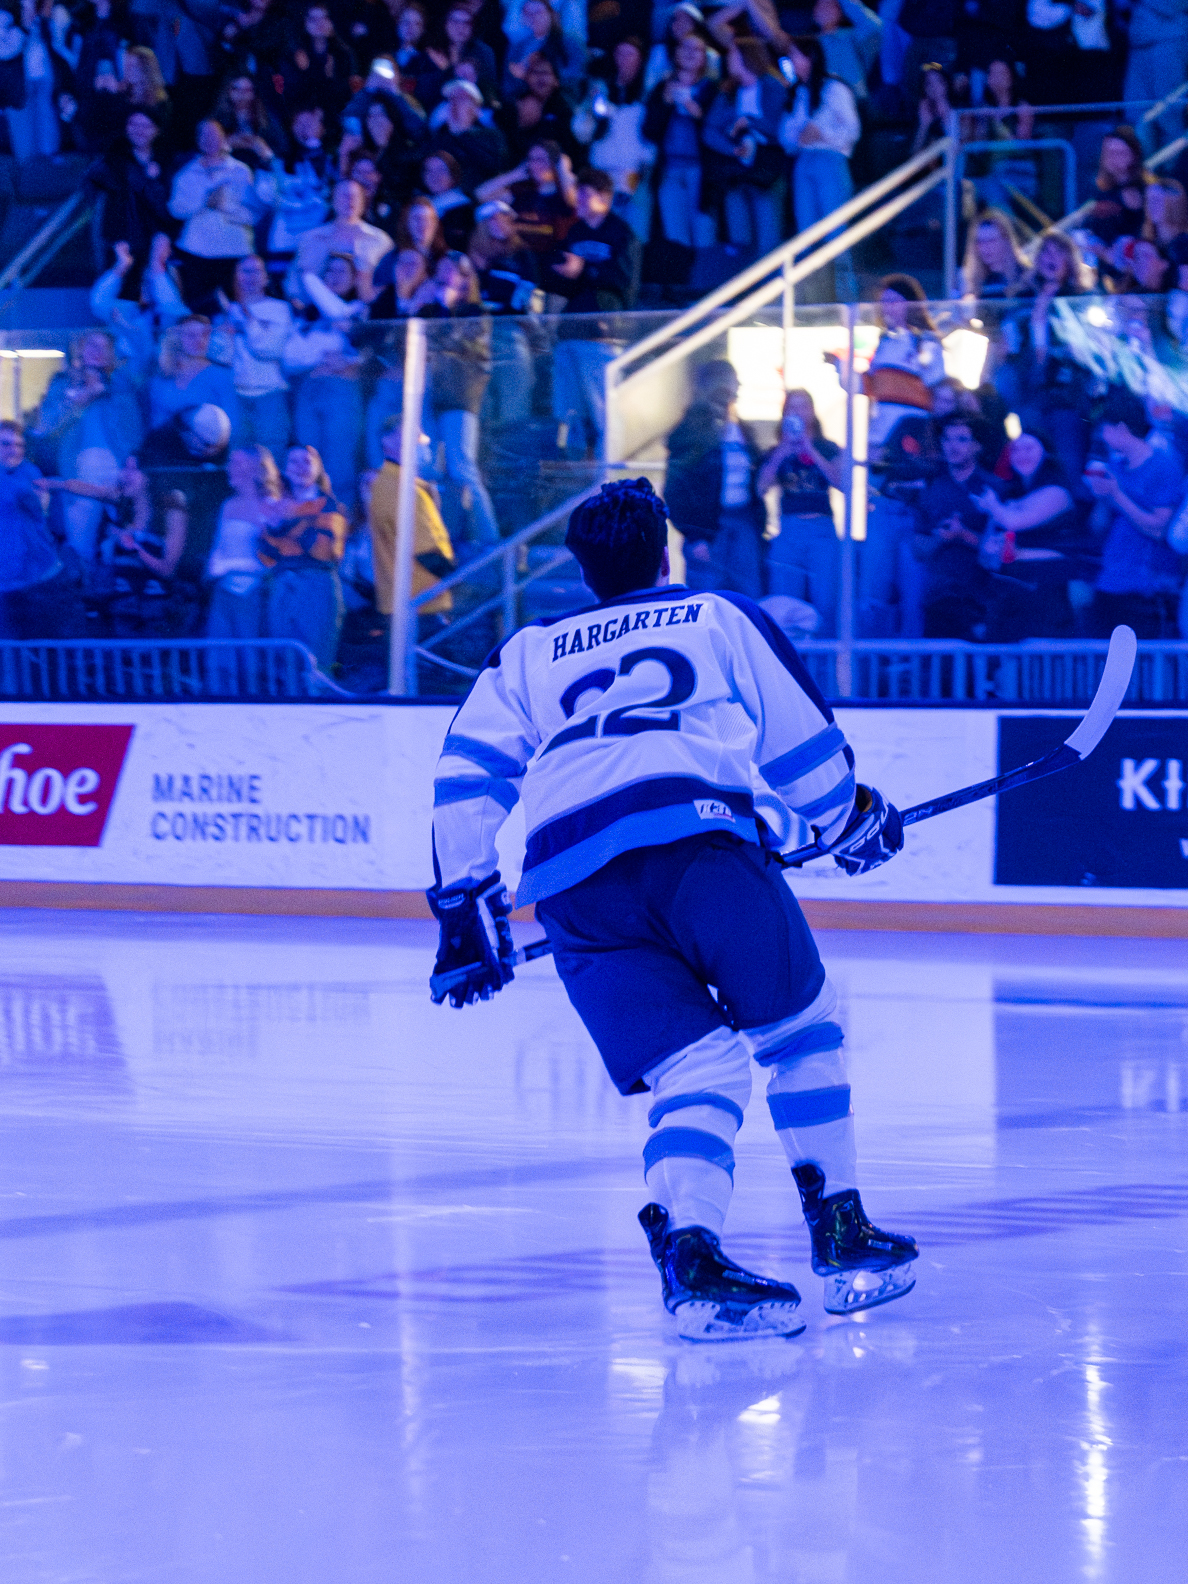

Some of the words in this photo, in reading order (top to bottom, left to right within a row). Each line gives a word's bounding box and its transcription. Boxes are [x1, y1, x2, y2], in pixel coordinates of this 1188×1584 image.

[552, 603, 704, 663] HARGARTEN
[536, 646, 699, 763] 22
[152, 773, 263, 803] MARINE
[150, 811, 372, 844] CONSTRUCTION
